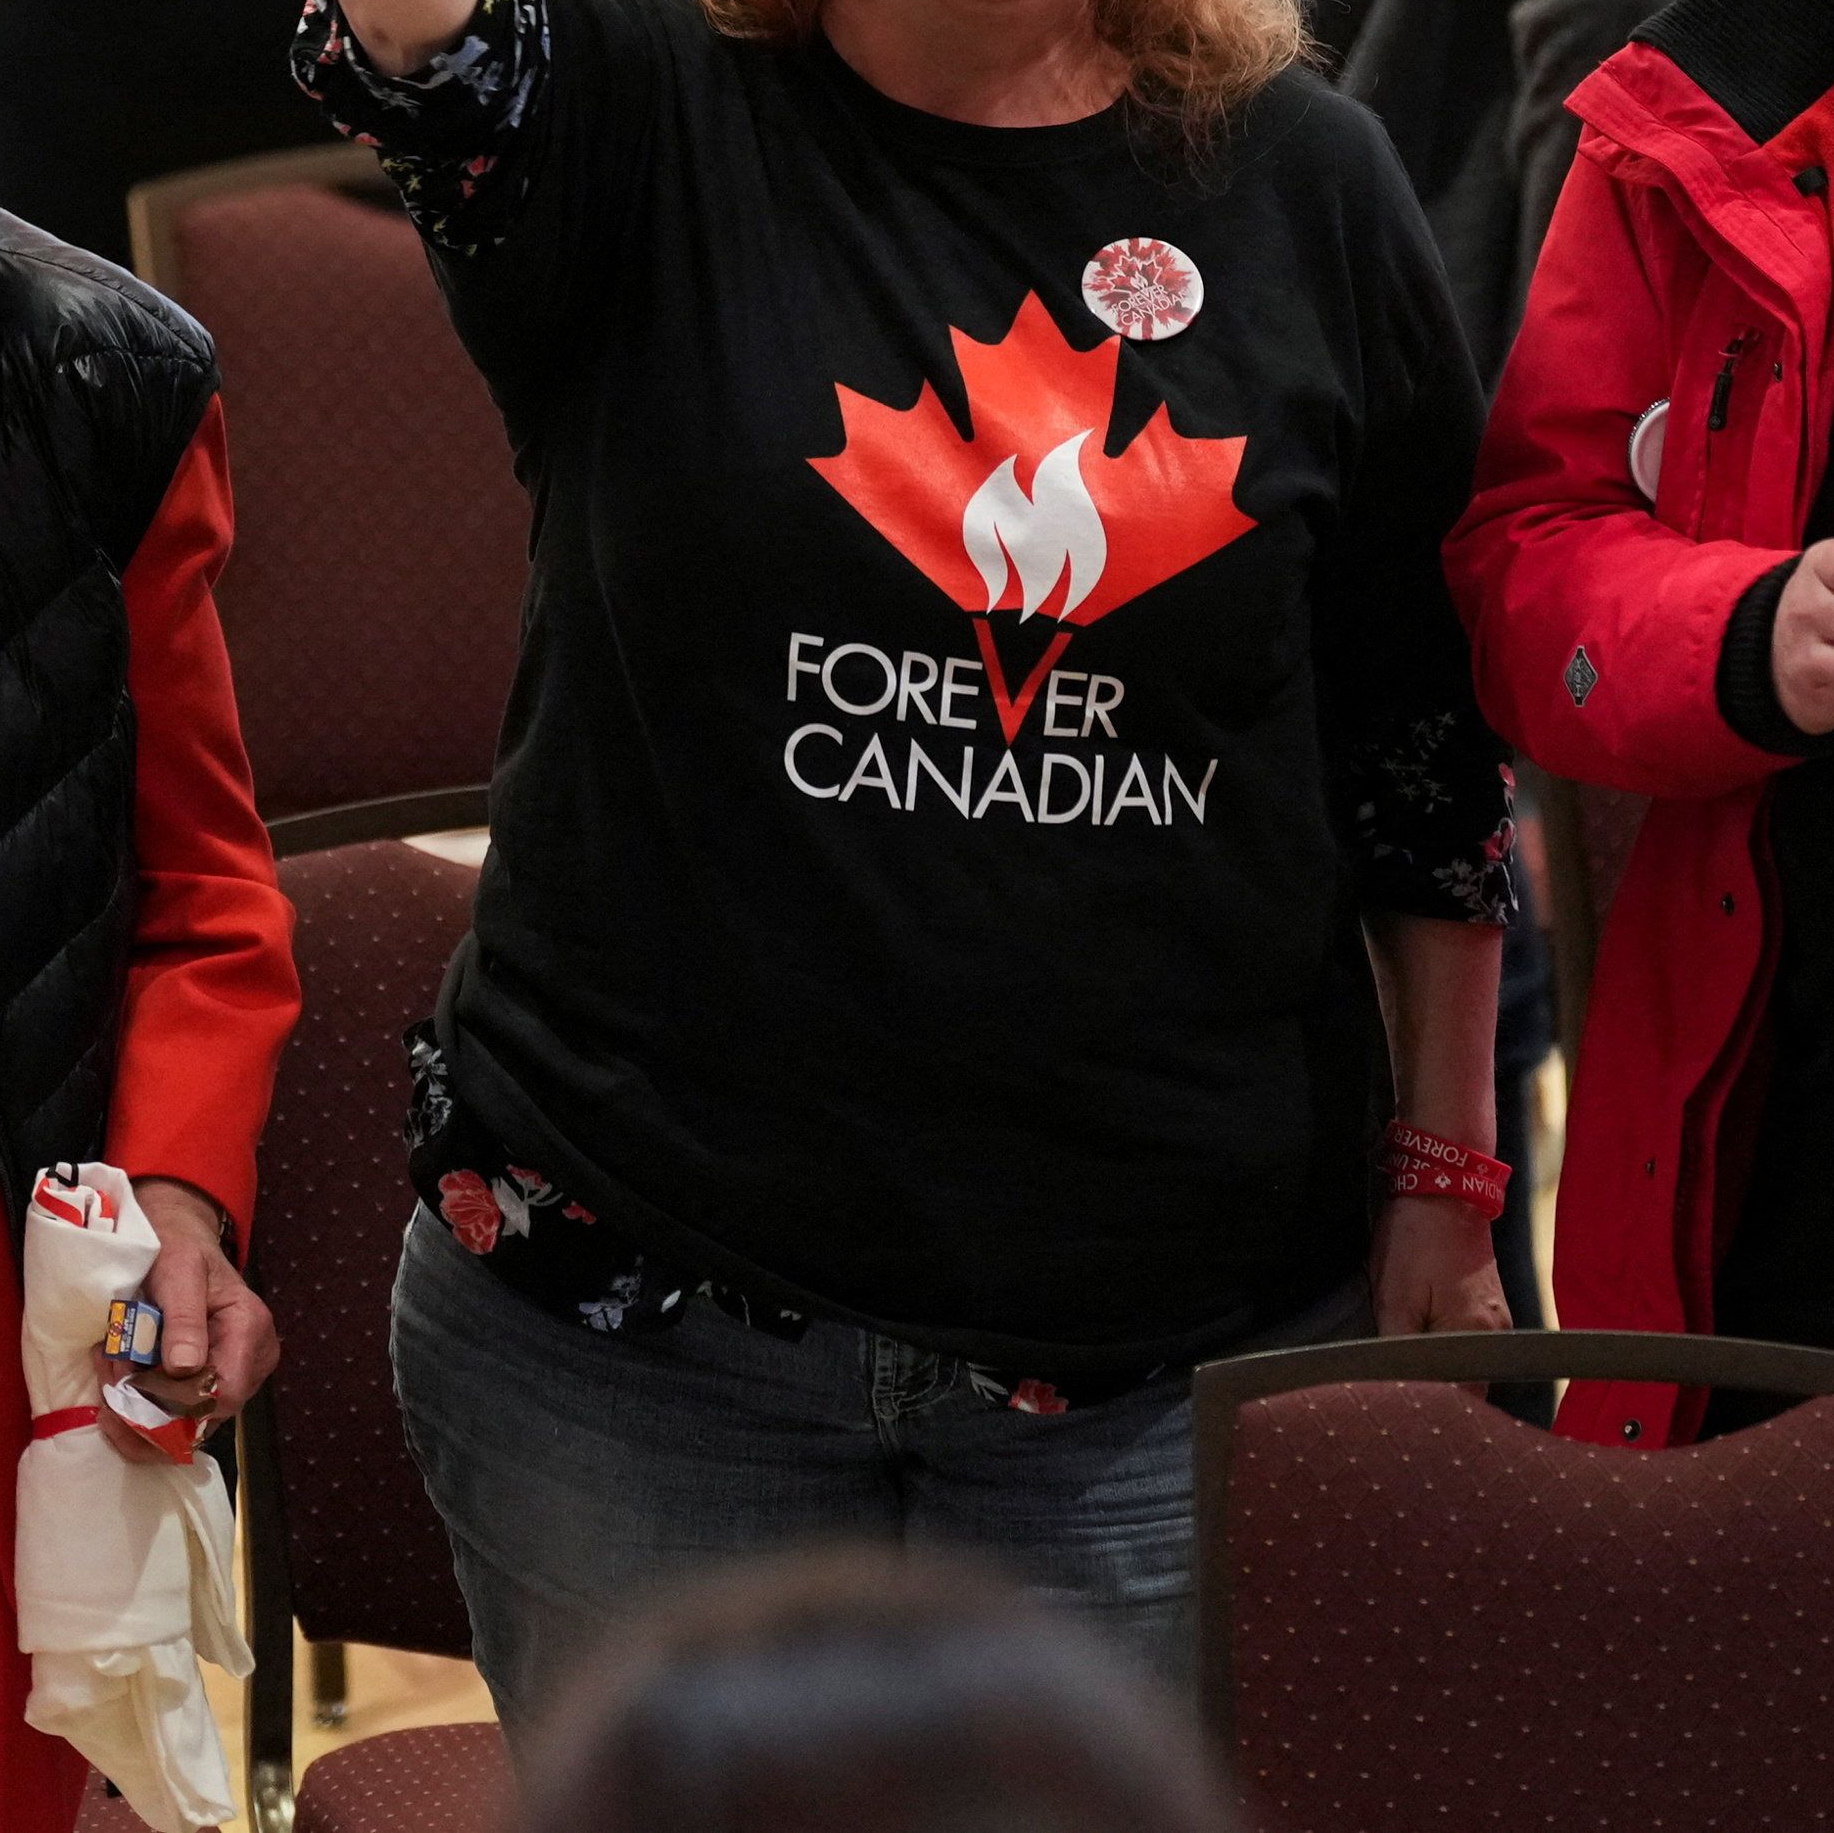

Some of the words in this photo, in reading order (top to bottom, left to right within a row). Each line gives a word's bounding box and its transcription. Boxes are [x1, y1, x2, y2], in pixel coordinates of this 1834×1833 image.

[1110, 283, 1169, 315] FOREVER
[1121, 287, 1191, 326] CANADIAN
[786, 617, 1126, 748] FOREVER
[783, 722, 1219, 826] CANADIAN
[1393, 1127, 1469, 1168] FOREVER
